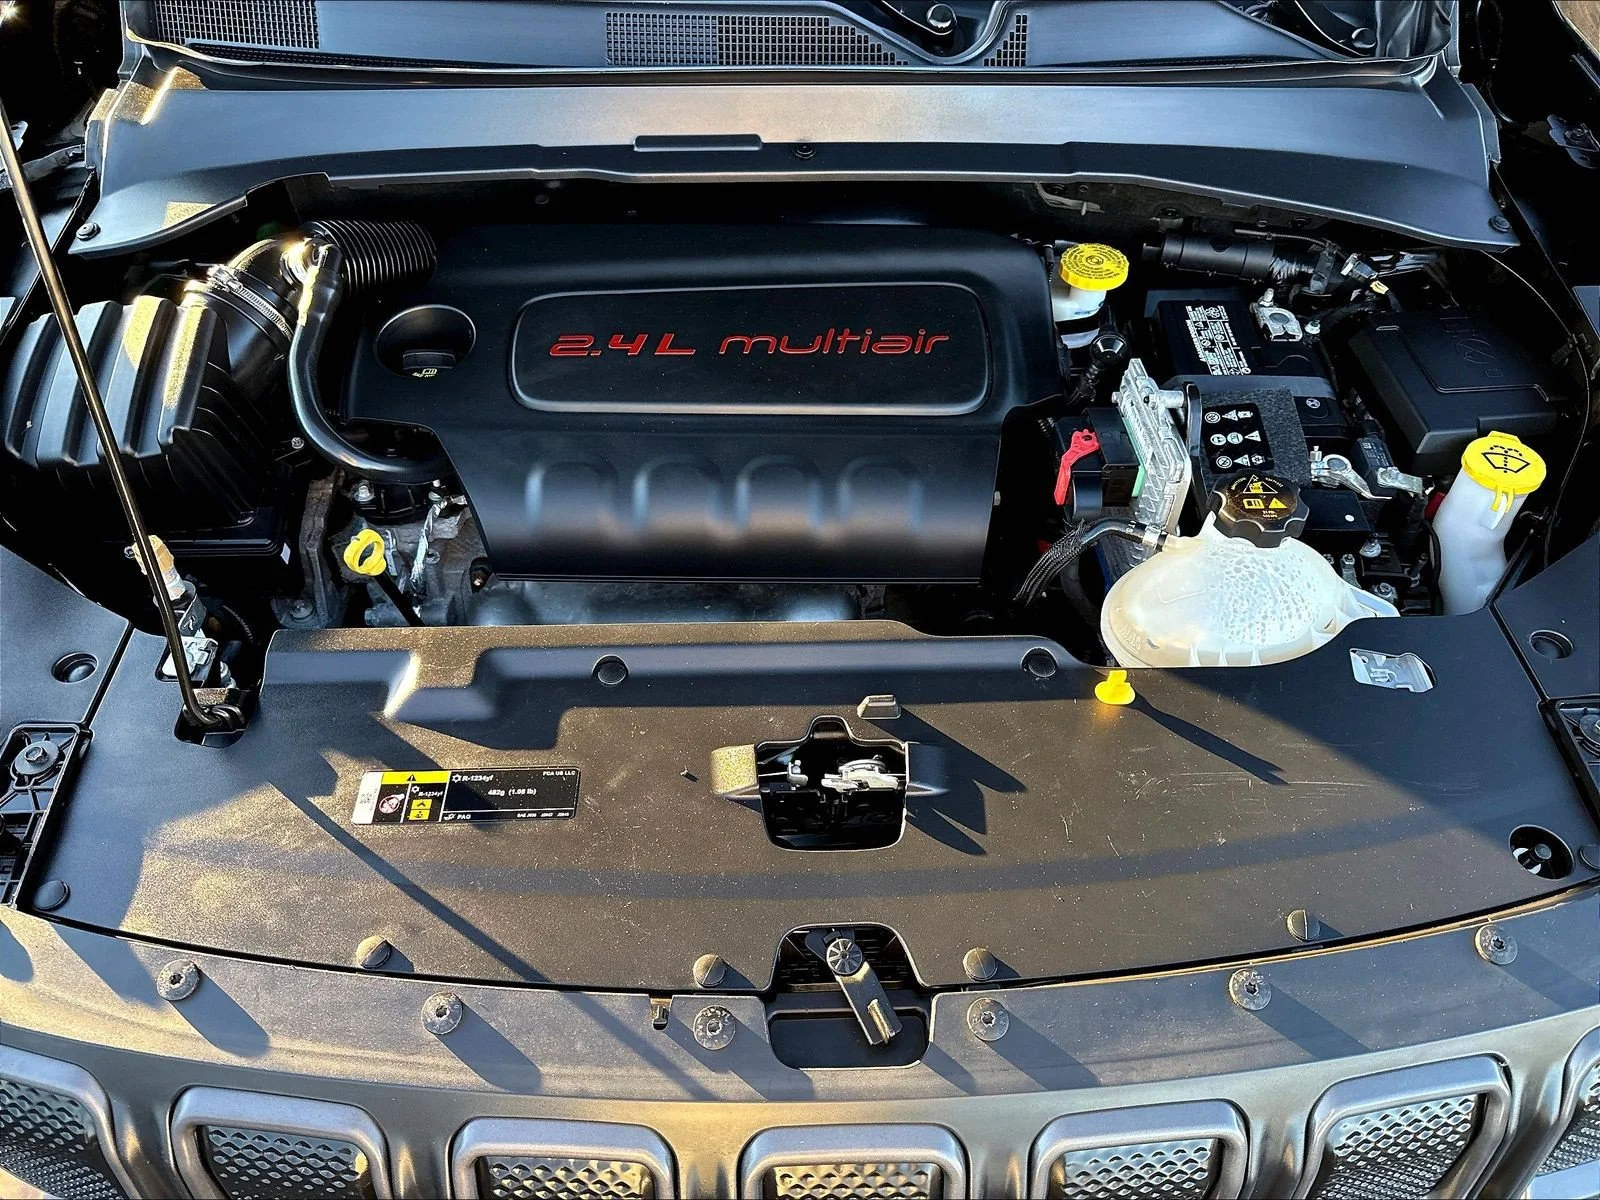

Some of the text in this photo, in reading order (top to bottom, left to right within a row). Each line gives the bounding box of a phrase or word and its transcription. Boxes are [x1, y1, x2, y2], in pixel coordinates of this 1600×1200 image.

[549, 328, 950, 357] 2.4L multiair
[462, 774, 494, 783] R-1234yf
